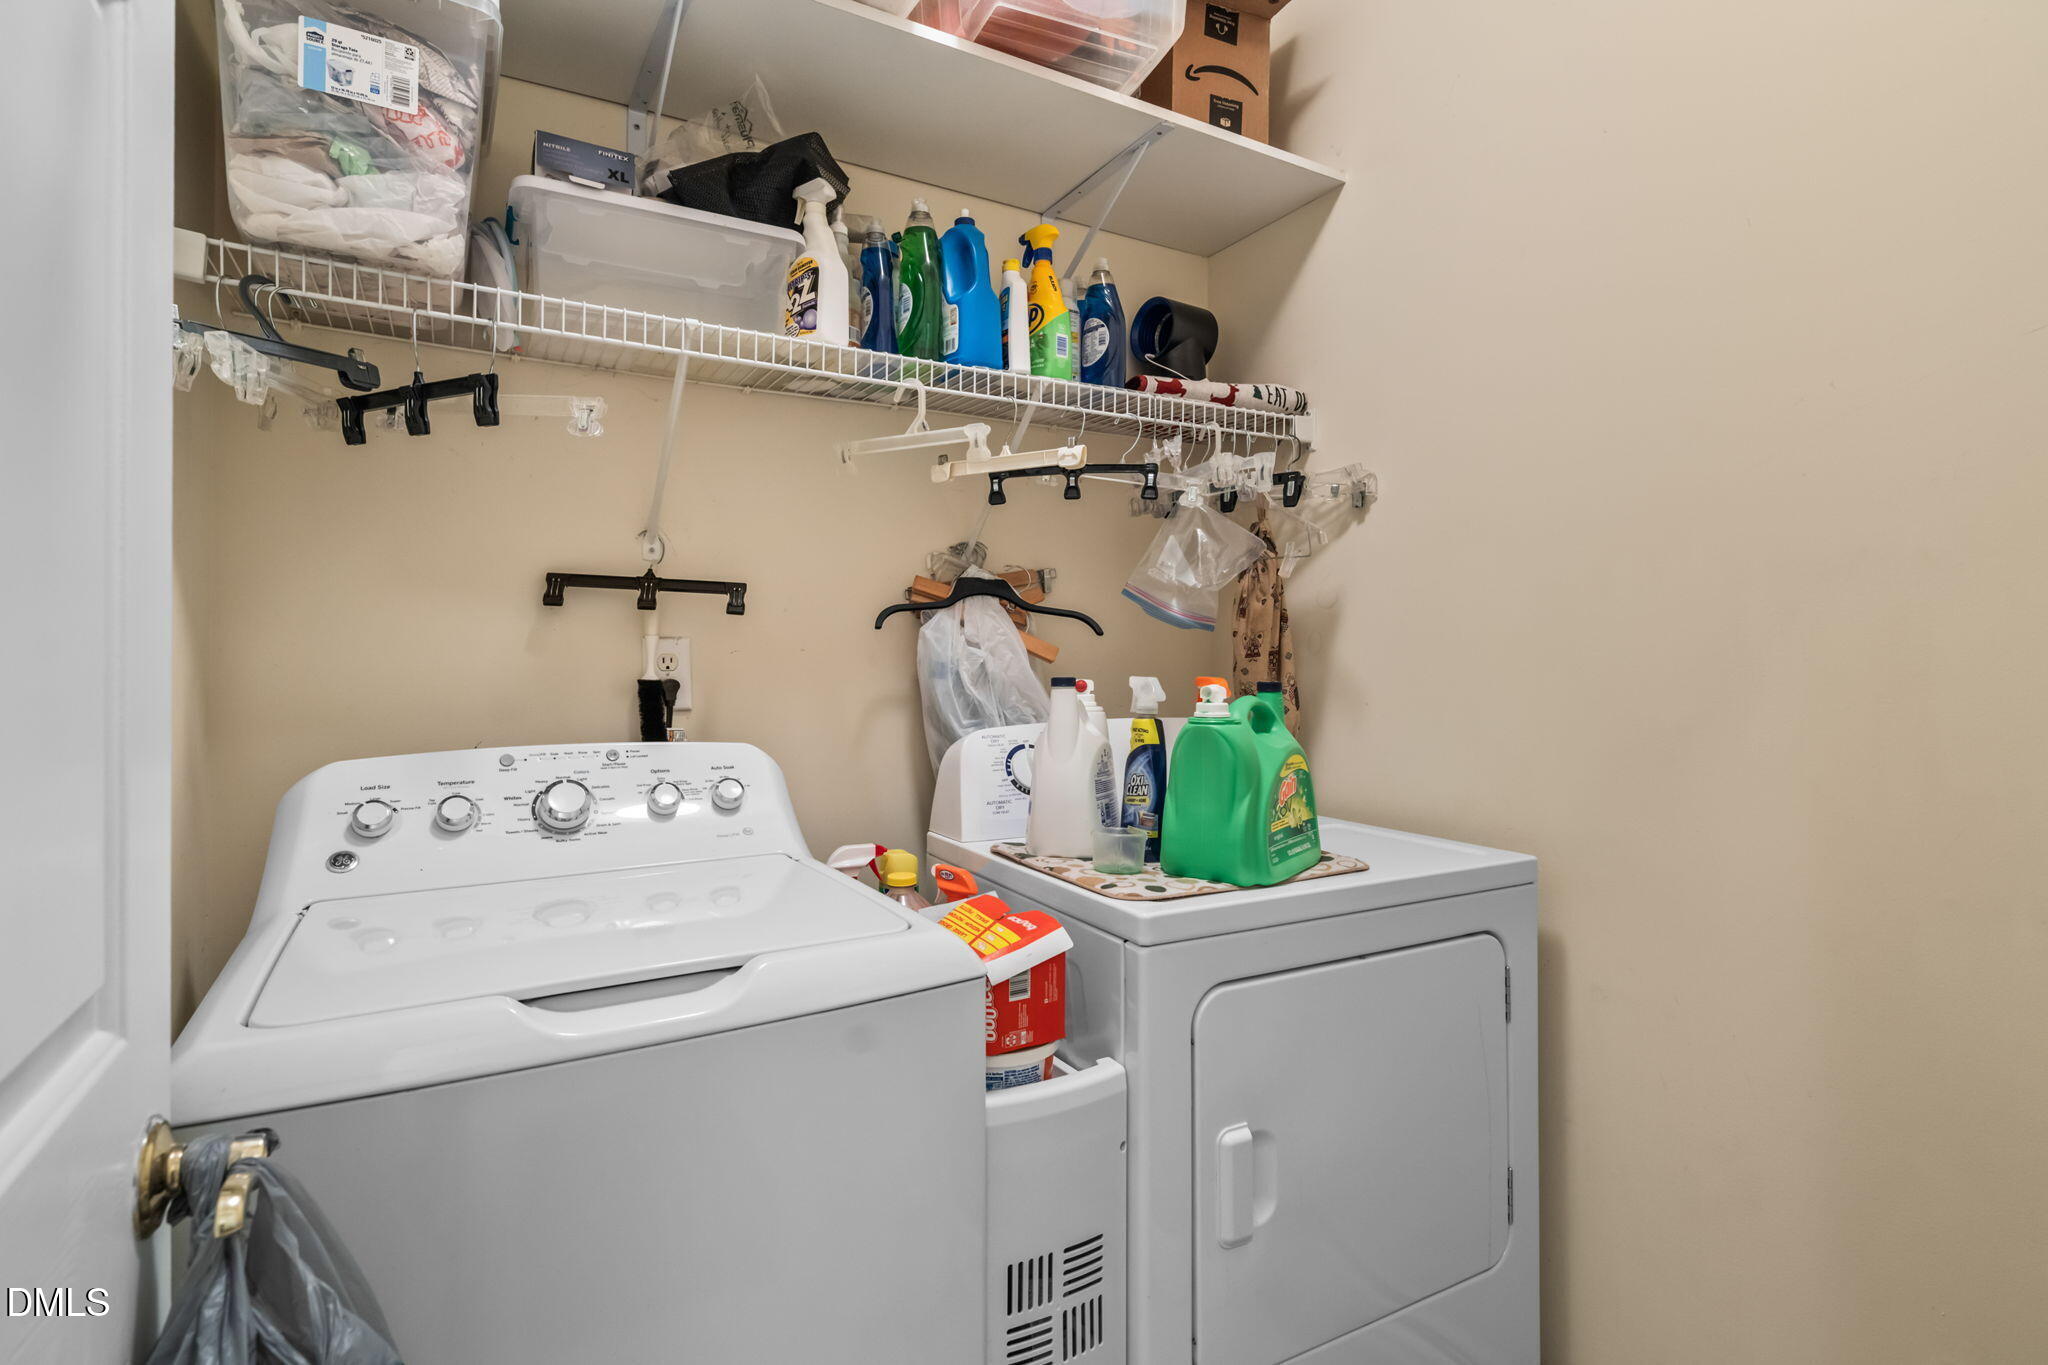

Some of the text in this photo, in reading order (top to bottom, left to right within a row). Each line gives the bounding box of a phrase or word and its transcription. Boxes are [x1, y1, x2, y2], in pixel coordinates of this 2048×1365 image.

[543, 142, 571, 152] NITRILE
[608, 168, 630, 184] XL
[1131, 774, 1144, 786] OXI
[1126, 784, 1149, 796] CLEAN
